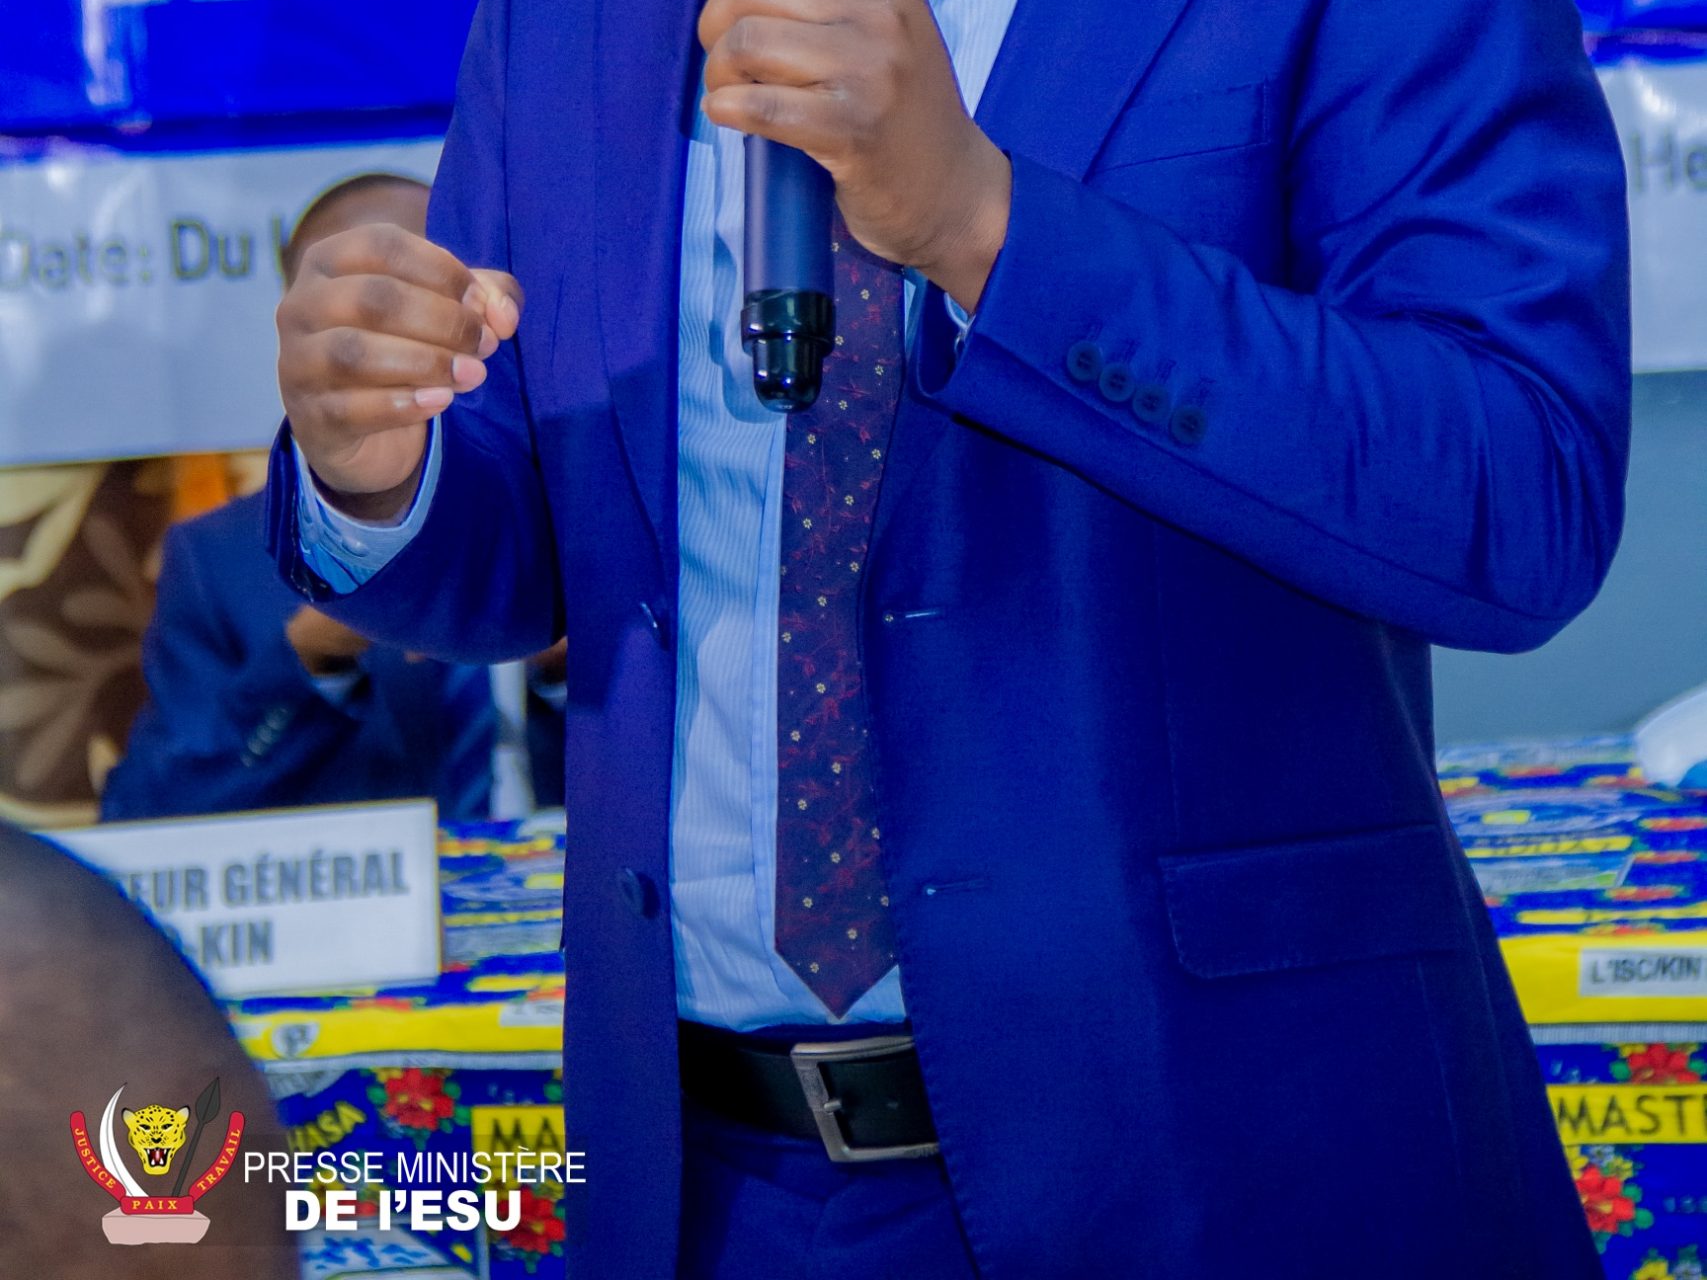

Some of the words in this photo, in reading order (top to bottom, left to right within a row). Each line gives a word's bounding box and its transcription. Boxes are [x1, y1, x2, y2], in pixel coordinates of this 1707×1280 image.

[169, 217, 250, 281] Du
[220, 850, 410, 909] GÉNÉRAL
[1557, 1093, 1707, 1137] MAST
